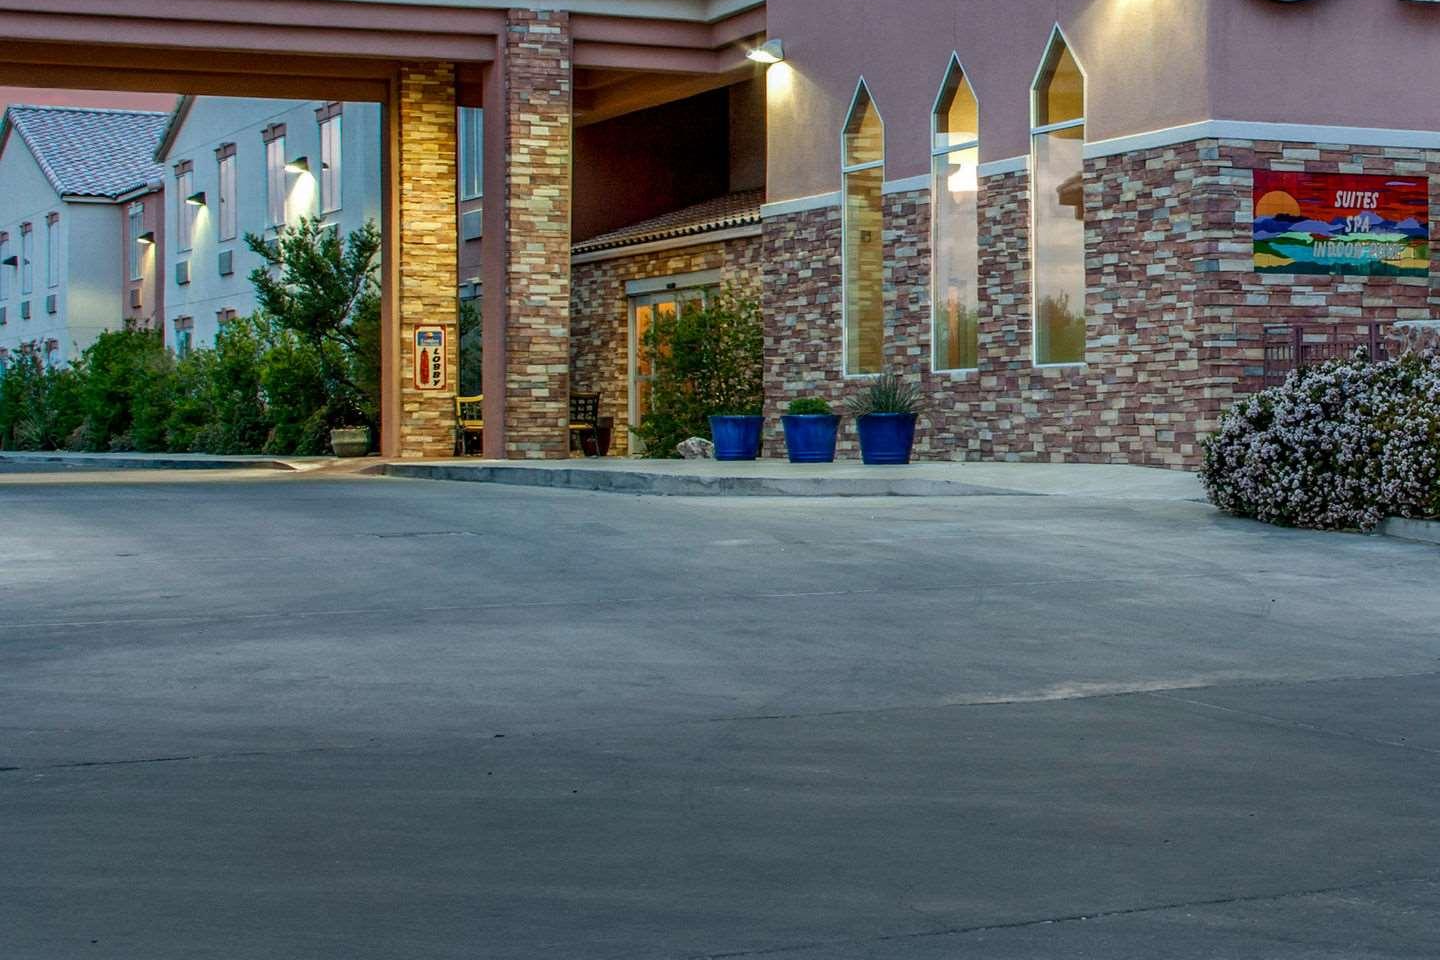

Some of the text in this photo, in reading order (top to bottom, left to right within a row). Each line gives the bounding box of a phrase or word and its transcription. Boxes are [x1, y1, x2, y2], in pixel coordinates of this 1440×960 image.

[1334, 190, 1379, 209] SUITES
[1345, 216, 1370, 233] SPA
[432, 348, 441, 386] LOBBY
